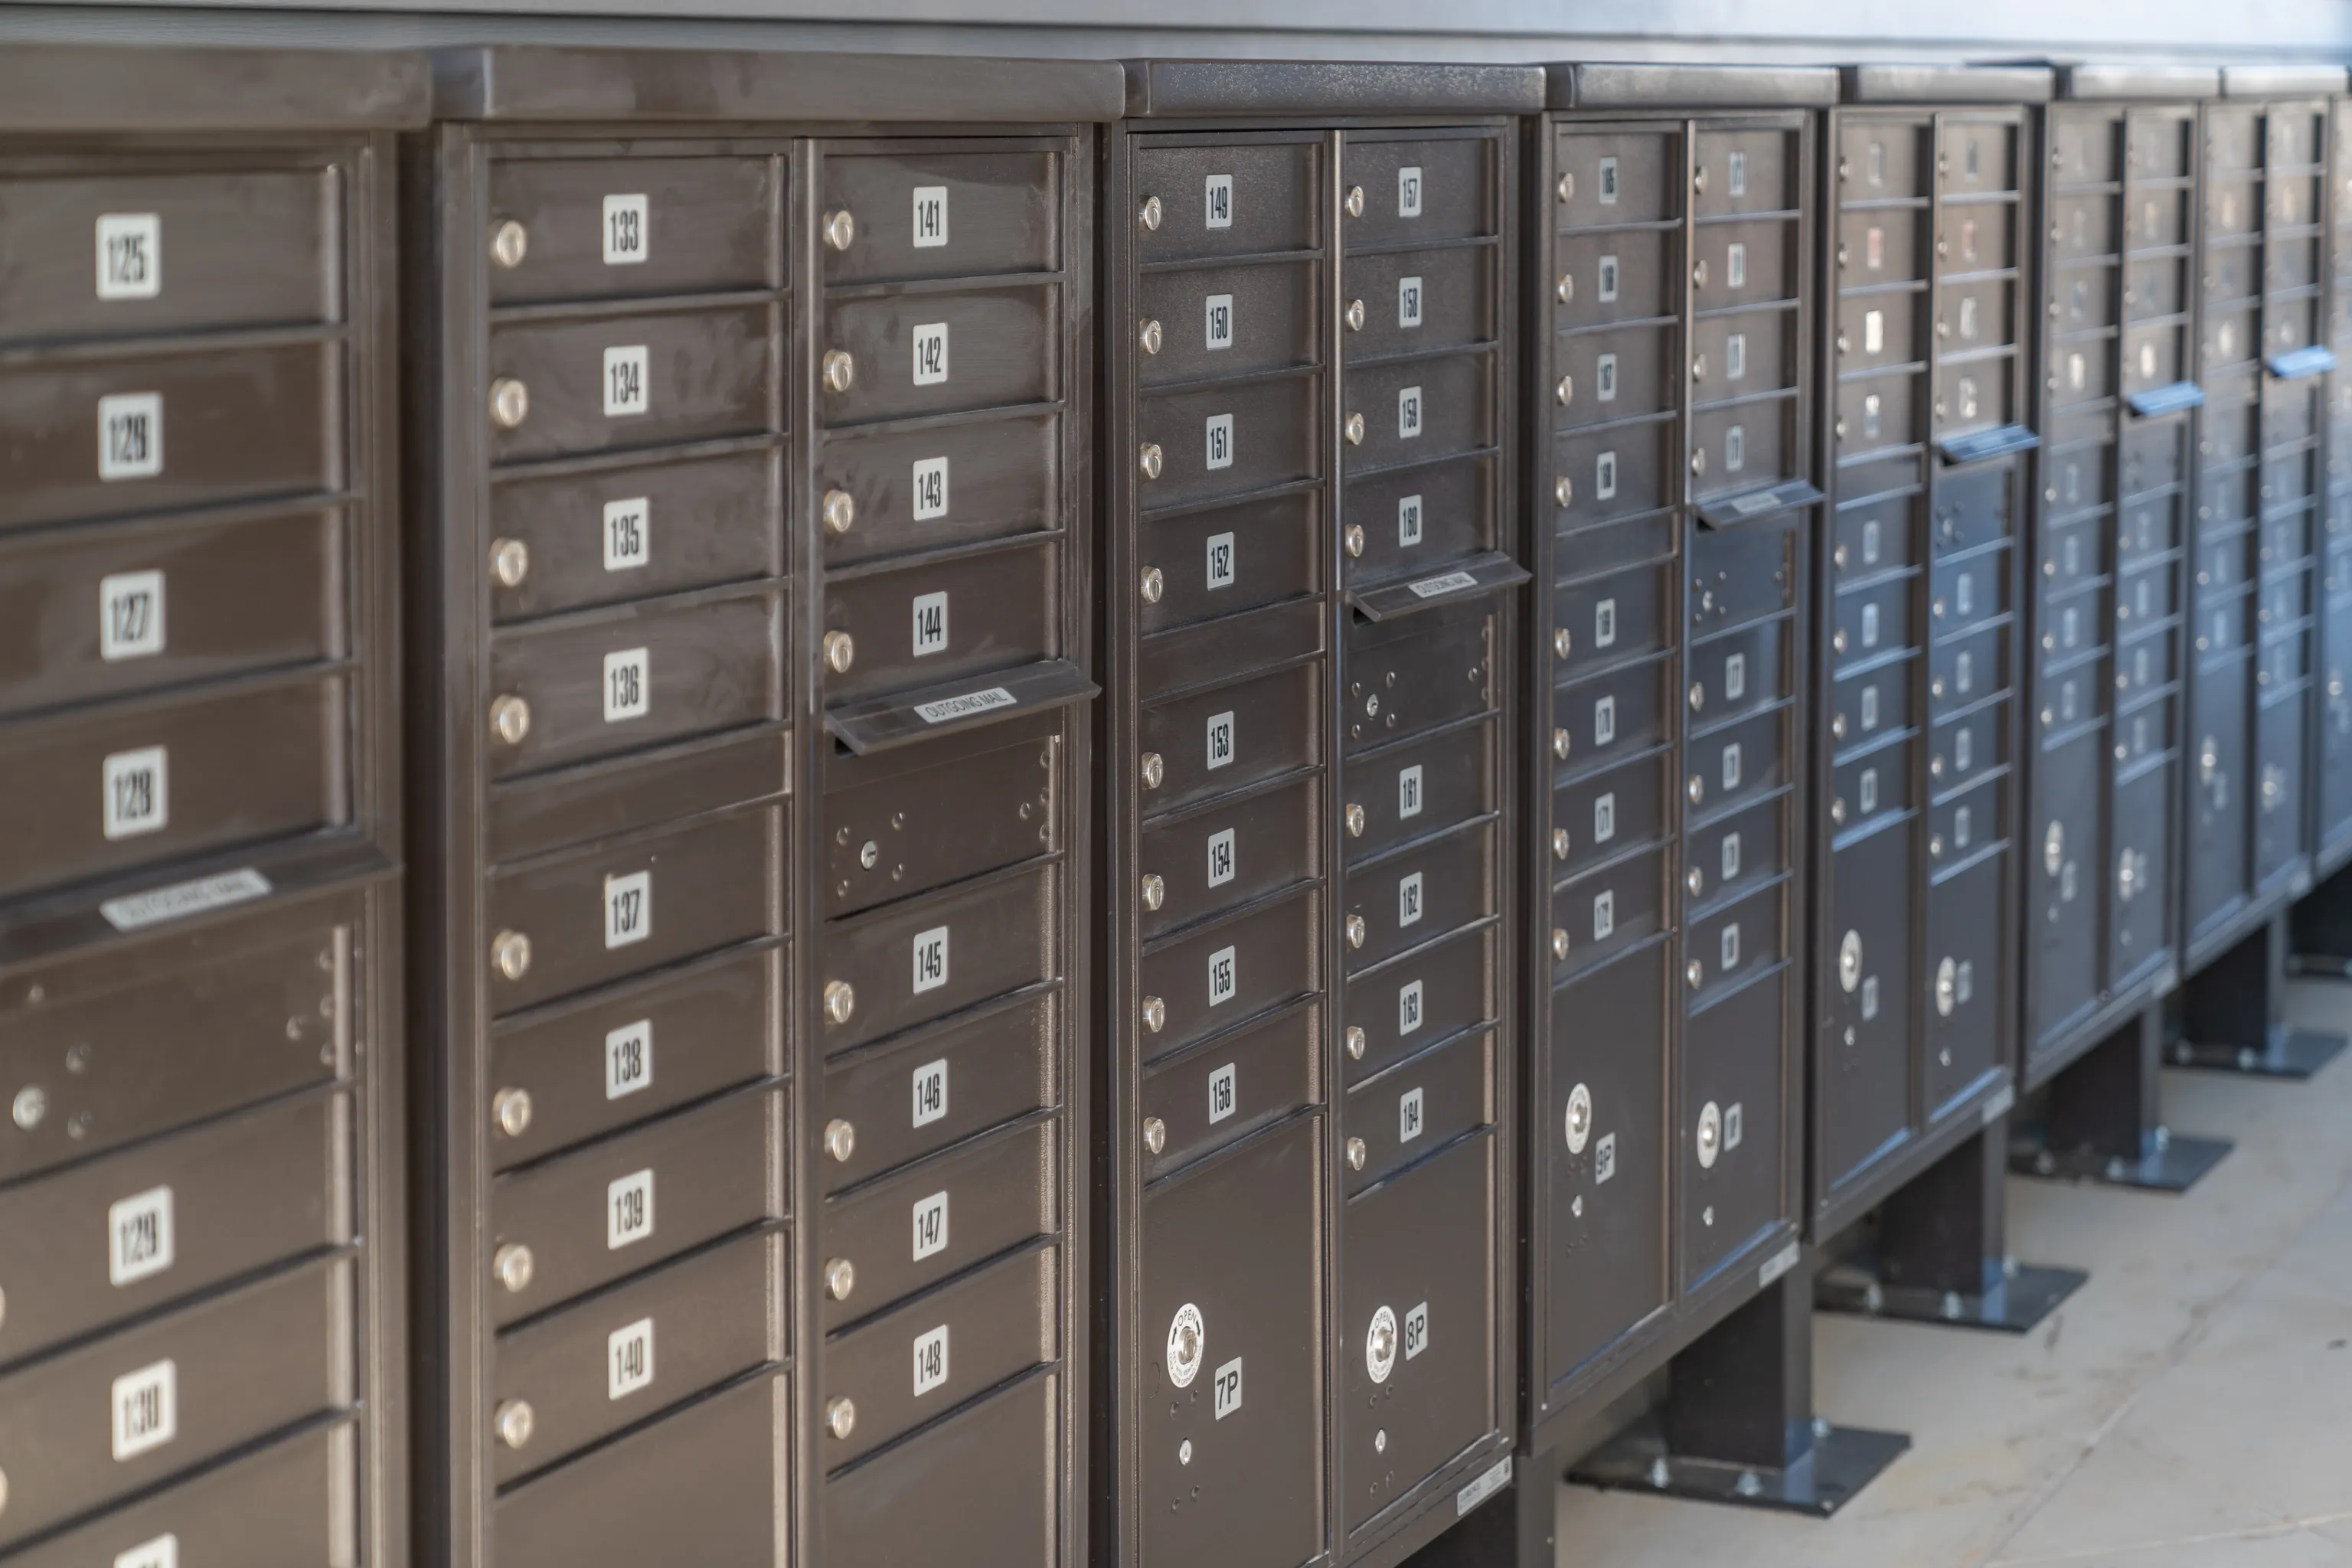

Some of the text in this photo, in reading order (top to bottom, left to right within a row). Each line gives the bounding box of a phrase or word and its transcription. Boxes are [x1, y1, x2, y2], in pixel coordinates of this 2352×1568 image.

[1210, 186, 1227, 219] 149
[1403, 178, 1417, 207] 157
[611, 211, 638, 252] 133
[919, 201, 939, 237] 141
[108, 234, 145, 283] 125
[1403, 288, 1417, 318] 158
[1210, 306, 1227, 339] 150
[919, 337, 941, 374] 142
[611, 362, 639, 403] 134
[1403, 398, 1416, 428] 159
[1210, 426, 1226, 459] 151
[919, 471, 940, 509] 143
[612, 514, 639, 557] 135
[1403, 506, 1417, 537] 160
[1211, 544, 1229, 579] 152
[113, 591, 151, 642] 127
[918, 606, 941, 645] 144
[612, 665, 639, 707] 136
[925, 691, 1008, 717] OUTGOING MAIL
[1211, 724, 1228, 759] 153
[1403, 778, 1416, 808] 161
[1212, 841, 1230, 877] 154
[612, 889, 640, 934] 137
[1403, 884, 1417, 916] 162
[919, 941, 941, 982] 145
[1213, 959, 1230, 995] 155
[1403, 992, 1417, 1025] 163
[614, 1038, 641, 1084] 138
[918, 1073, 939, 1115] 146
[1214, 1076, 1230, 1113] 156
[1404, 1100, 1418, 1133] 164
[1597, 1145, 1612, 1176] 9P
[616, 1187, 642, 1233] 139
[919, 1207, 940, 1249] 147
[122, 1210, 158, 1266] 129
[1178, 1309, 1197, 1326] OPEN
[1375, 1312, 1390, 1328] OPEN
[1407, 1315, 1424, 1350] 8P
[617, 1337, 643, 1383] 140
[919, 1340, 940, 1383] 148
[1217, 1370, 1238, 1410] 7P
